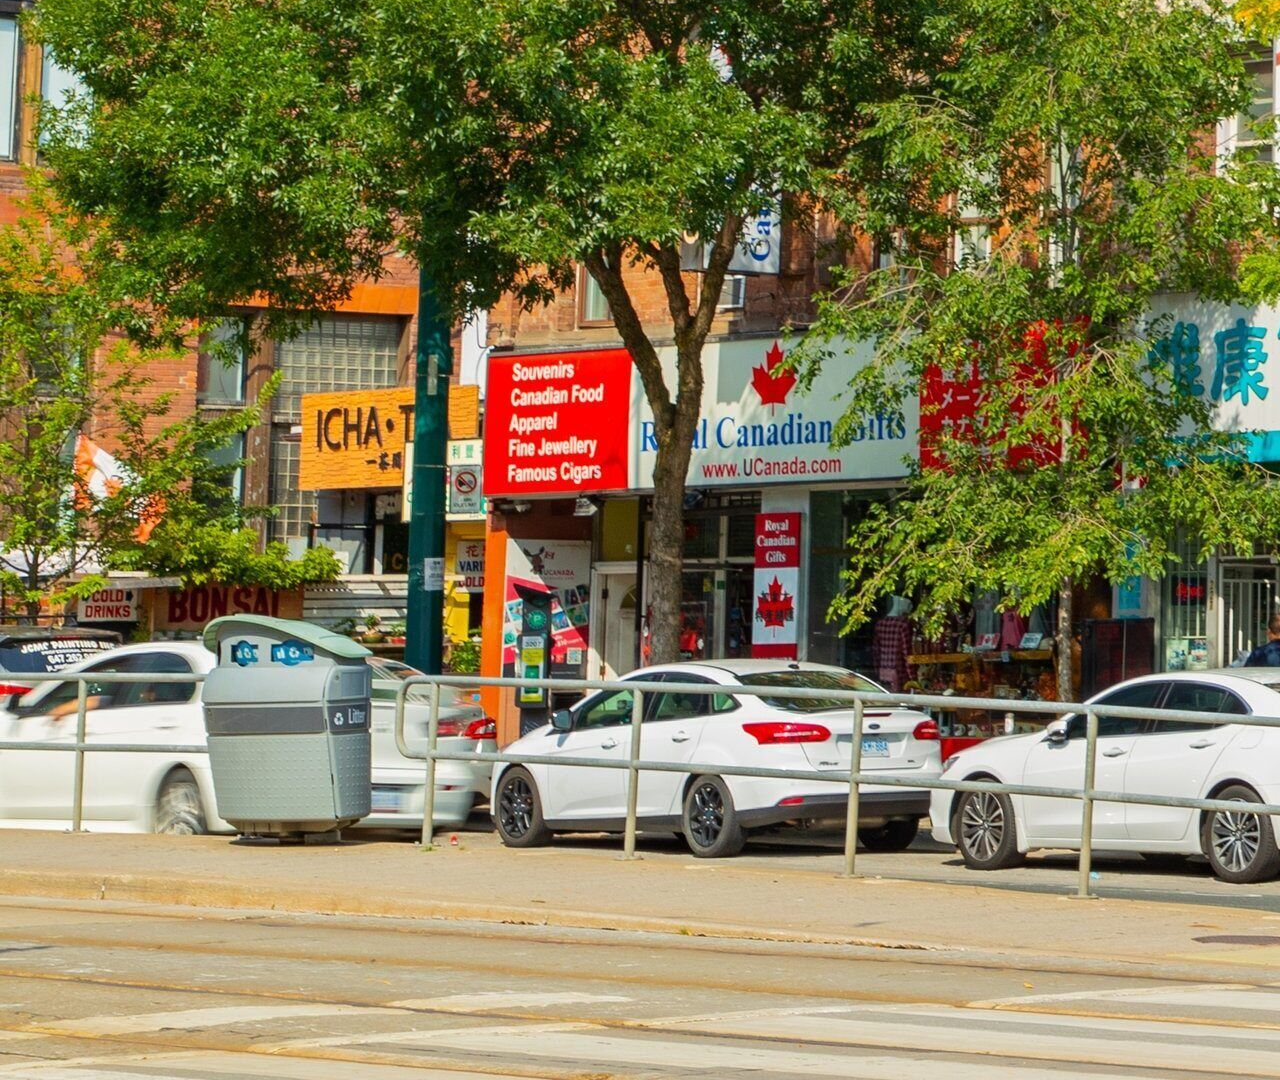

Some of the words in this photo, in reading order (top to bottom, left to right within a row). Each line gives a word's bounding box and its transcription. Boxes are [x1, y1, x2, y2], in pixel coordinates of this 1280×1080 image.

[512, 361, 575, 382] Souvenirs
[510, 386, 569, 407] Canadian
[571, 383, 604, 403] Food
[316, 406, 383, 452] ICHA
[509, 411, 557, 435] Apparel
[640, 420, 708, 452] Ral
[716, 413, 832, 449] Canadian
[508, 439, 536, 458] Fine
[537, 436, 598, 458] Jewellery
[507, 464, 557, 483] Famous
[560, 461, 602, 484] Cigars
[765, 519, 790, 535] Royal
[756, 535, 796, 547] Canadian
[765, 550, 787, 564] Gifts
[92, 588, 124, 603] COLD
[84, 604, 131, 619] DRINKS
[50, 639, 98, 650] PAINTING
[348, 708, 366, 724] Litter
